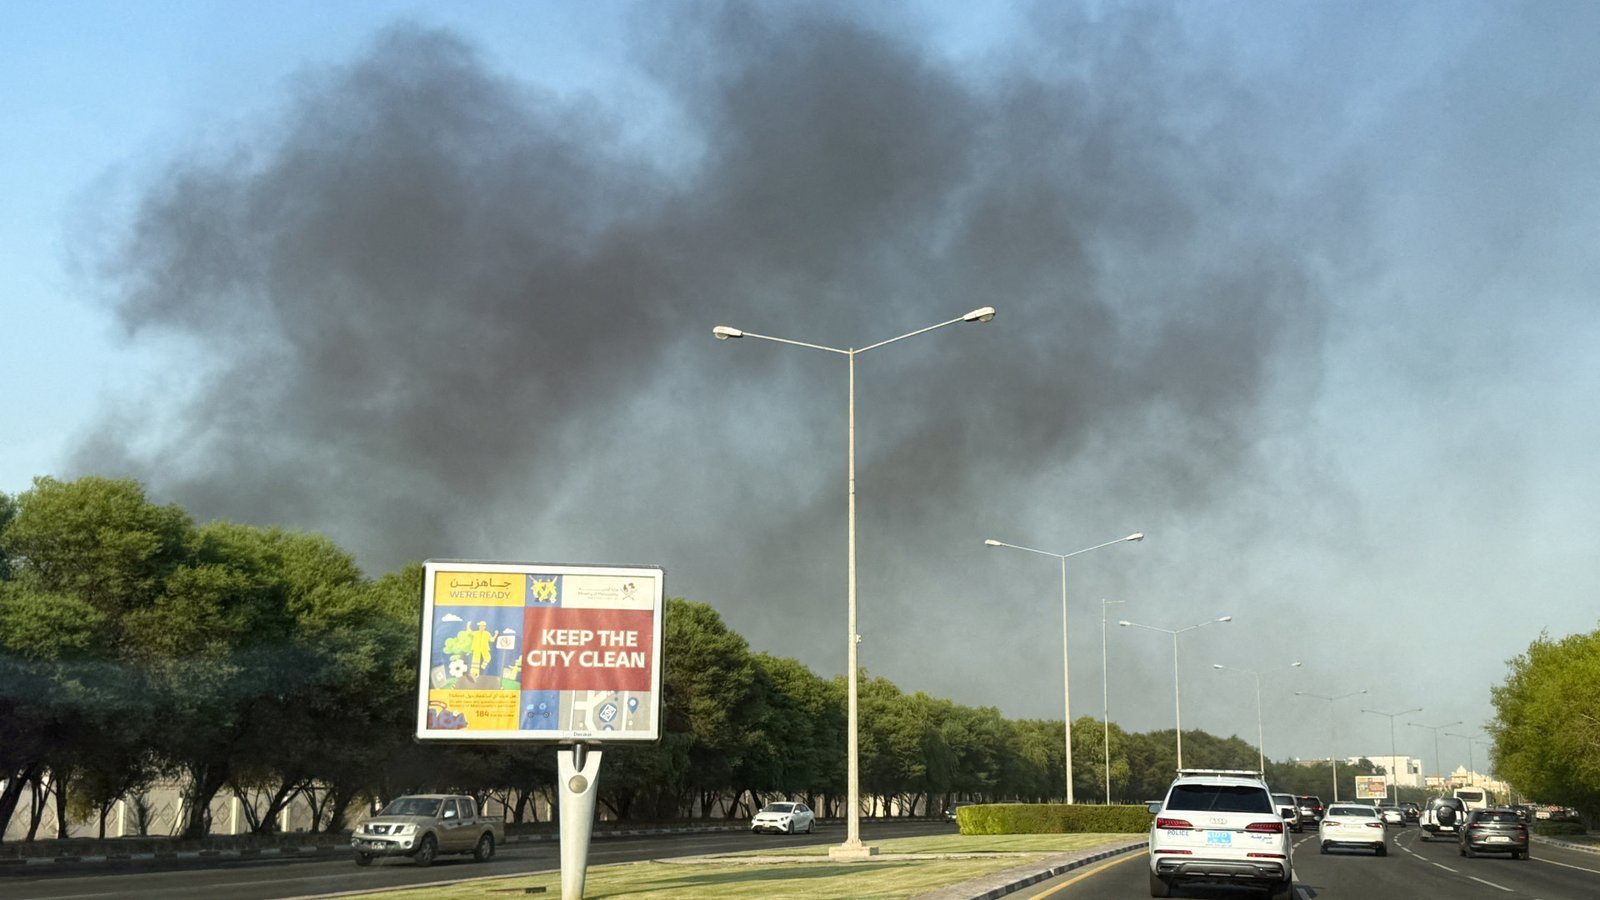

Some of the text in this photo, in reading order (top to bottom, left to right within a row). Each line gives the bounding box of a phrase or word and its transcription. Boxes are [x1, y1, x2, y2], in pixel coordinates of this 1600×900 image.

[450, 577, 512, 590] جاهزين
[479, 591, 511, 599] READY
[541, 629, 639, 647] KEEP THE
[526, 649, 646, 669] CITY CLEAN
[476, 710, 490, 718] 184
[1167, 829, 1189, 837] POLICE
